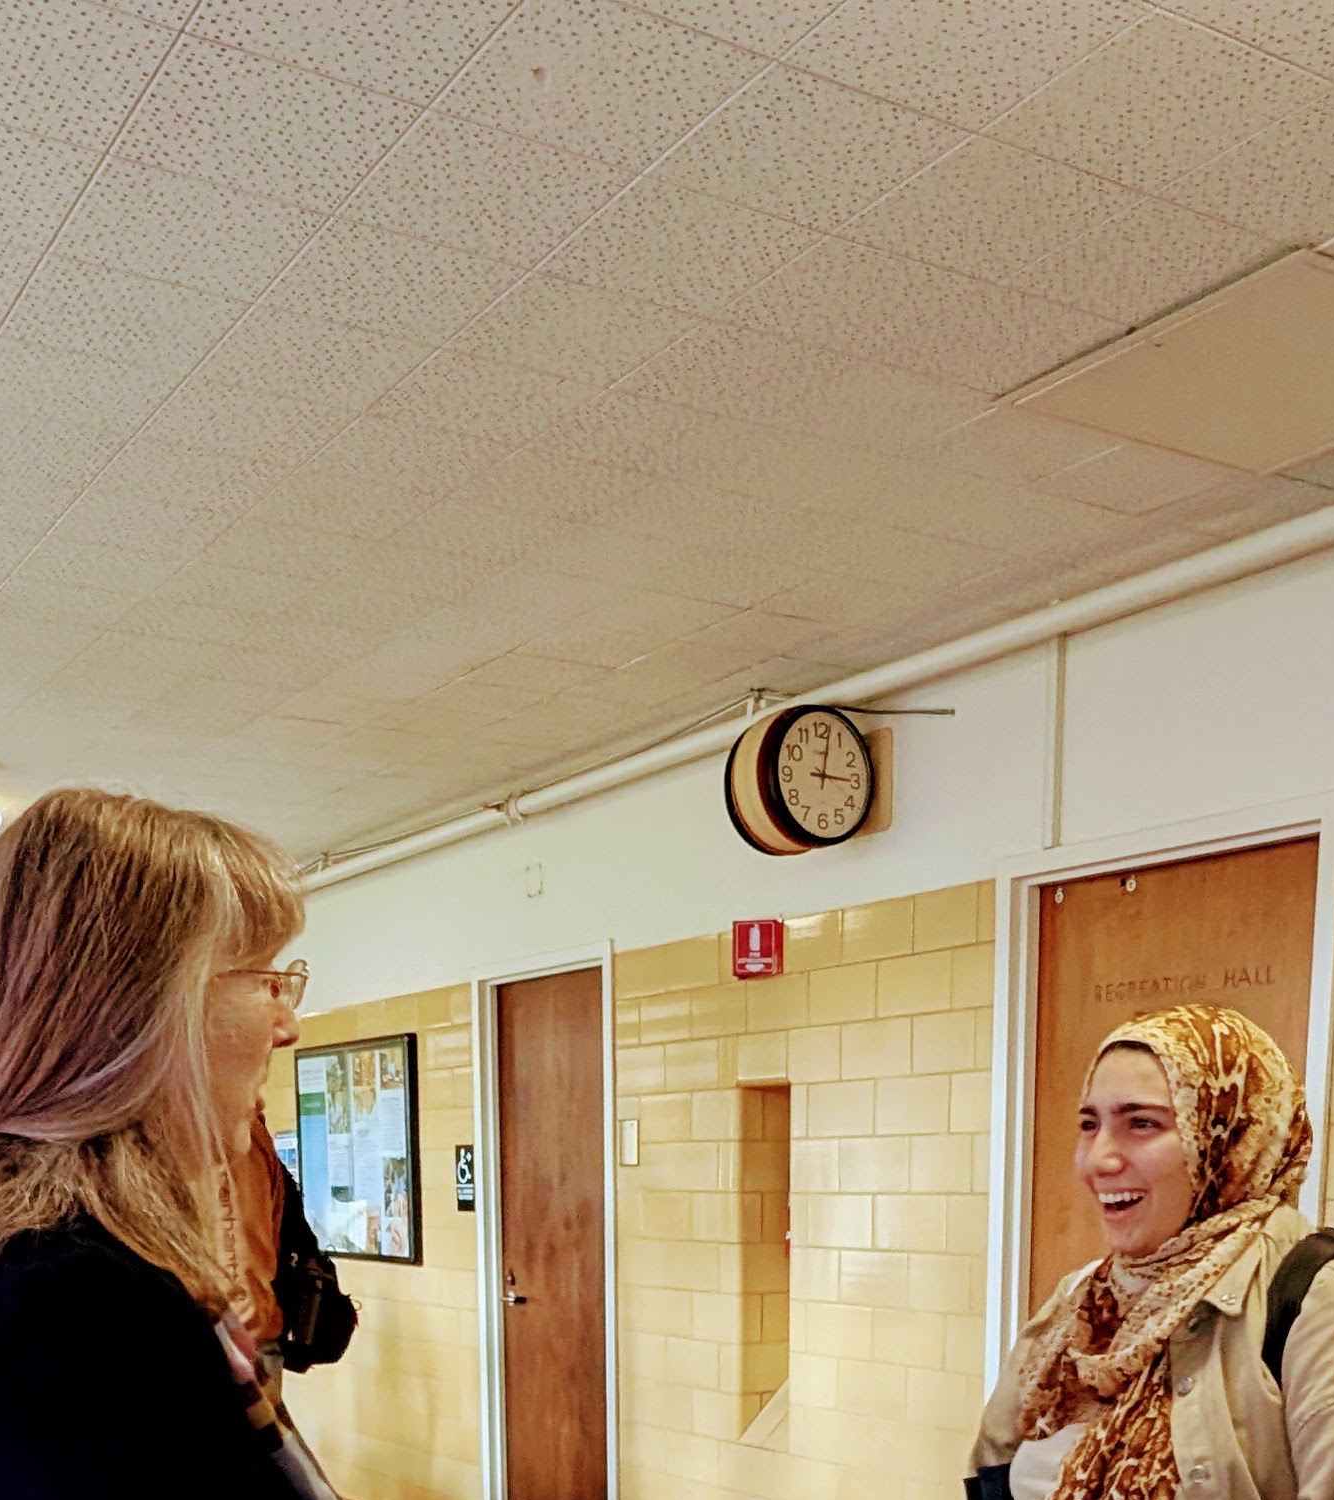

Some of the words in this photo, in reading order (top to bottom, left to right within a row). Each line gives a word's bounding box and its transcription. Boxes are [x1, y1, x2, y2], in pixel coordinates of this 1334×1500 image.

[798, 727, 809, 744] 11
[813, 722, 828, 739] 12
[837, 732, 842, 749] 1
[785, 744, 803, 762] 10
[846, 751, 857, 768] 2
[781, 765, 793, 783] 9
[850, 773, 861, 790] 3
[788, 789, 800, 806] 8
[844, 795, 856, 811] 4
[800, 805, 811, 822] 7
[817, 813, 828, 830] 6
[834, 808, 845, 825] 5
[1094, 974, 1206, 1003] RECREATION
[1222, 964, 1276, 989] HALL
